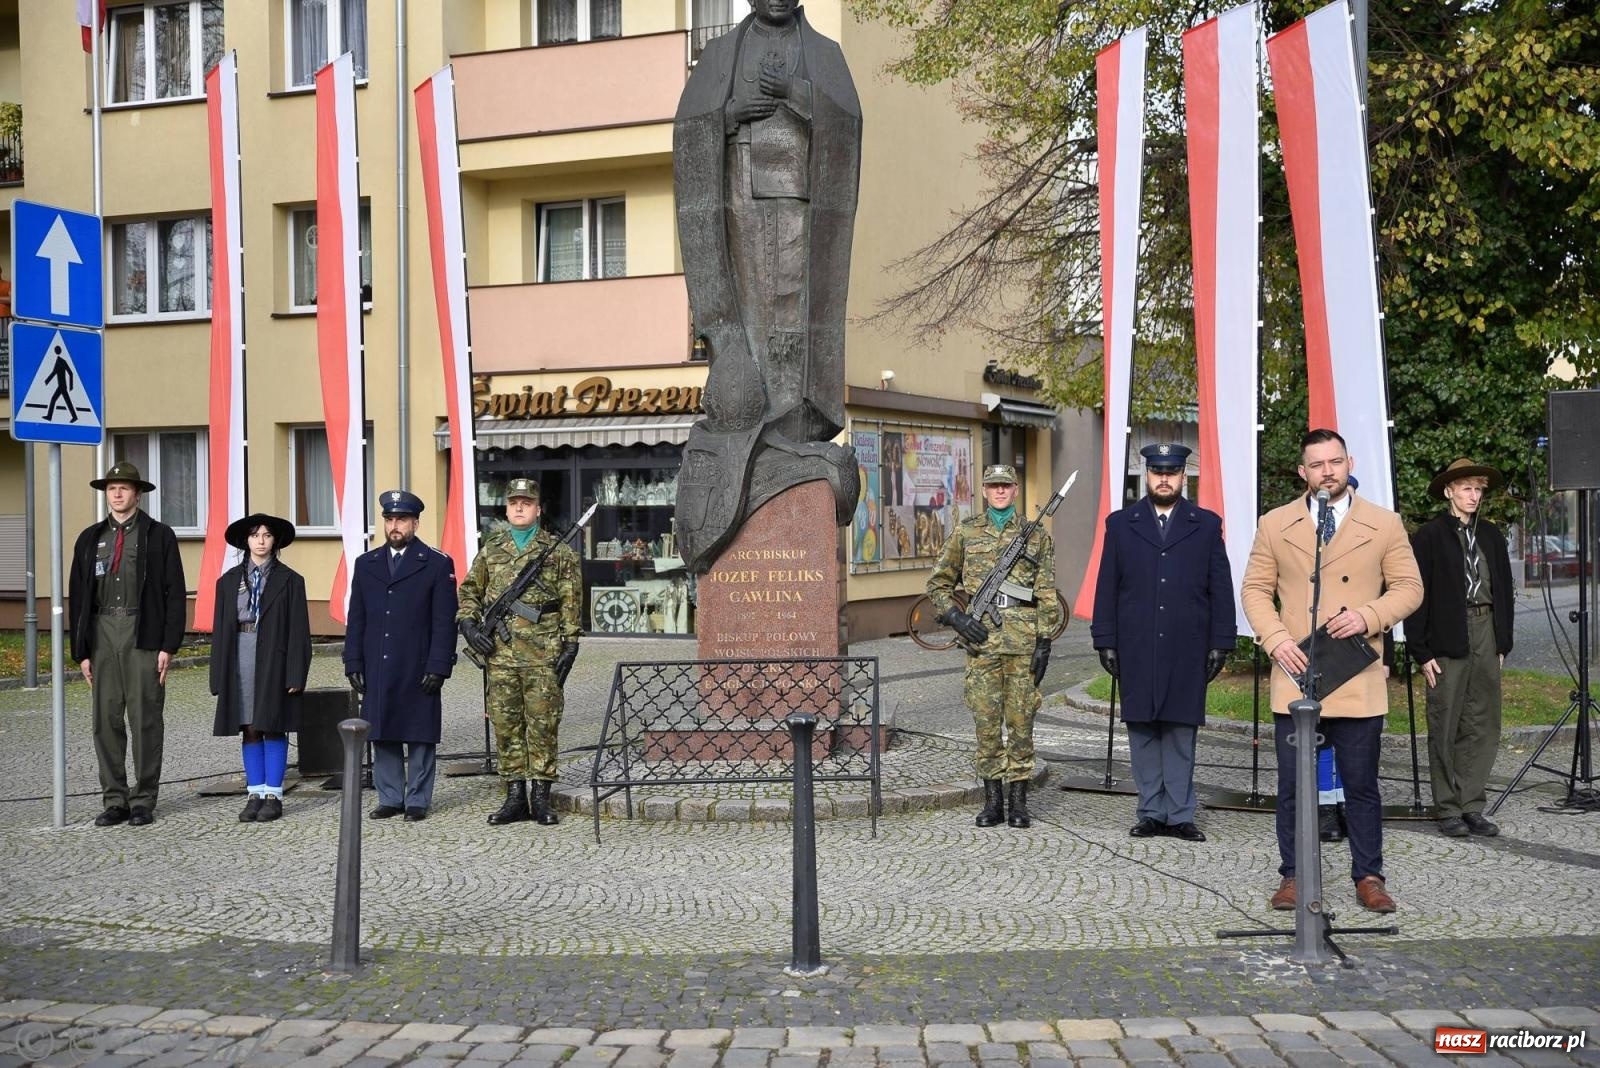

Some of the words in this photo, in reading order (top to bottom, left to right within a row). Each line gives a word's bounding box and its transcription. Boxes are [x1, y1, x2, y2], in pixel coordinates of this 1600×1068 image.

[730, 549, 807, 560] ARCYBISKUP
[768, 569, 824, 582] FELIKS
[717, 632, 759, 642] BISKUP
[766, 631, 818, 642] POLOWY
[714, 647, 754, 658] WOJSK
[760, 647, 820, 657] POLSKICH
